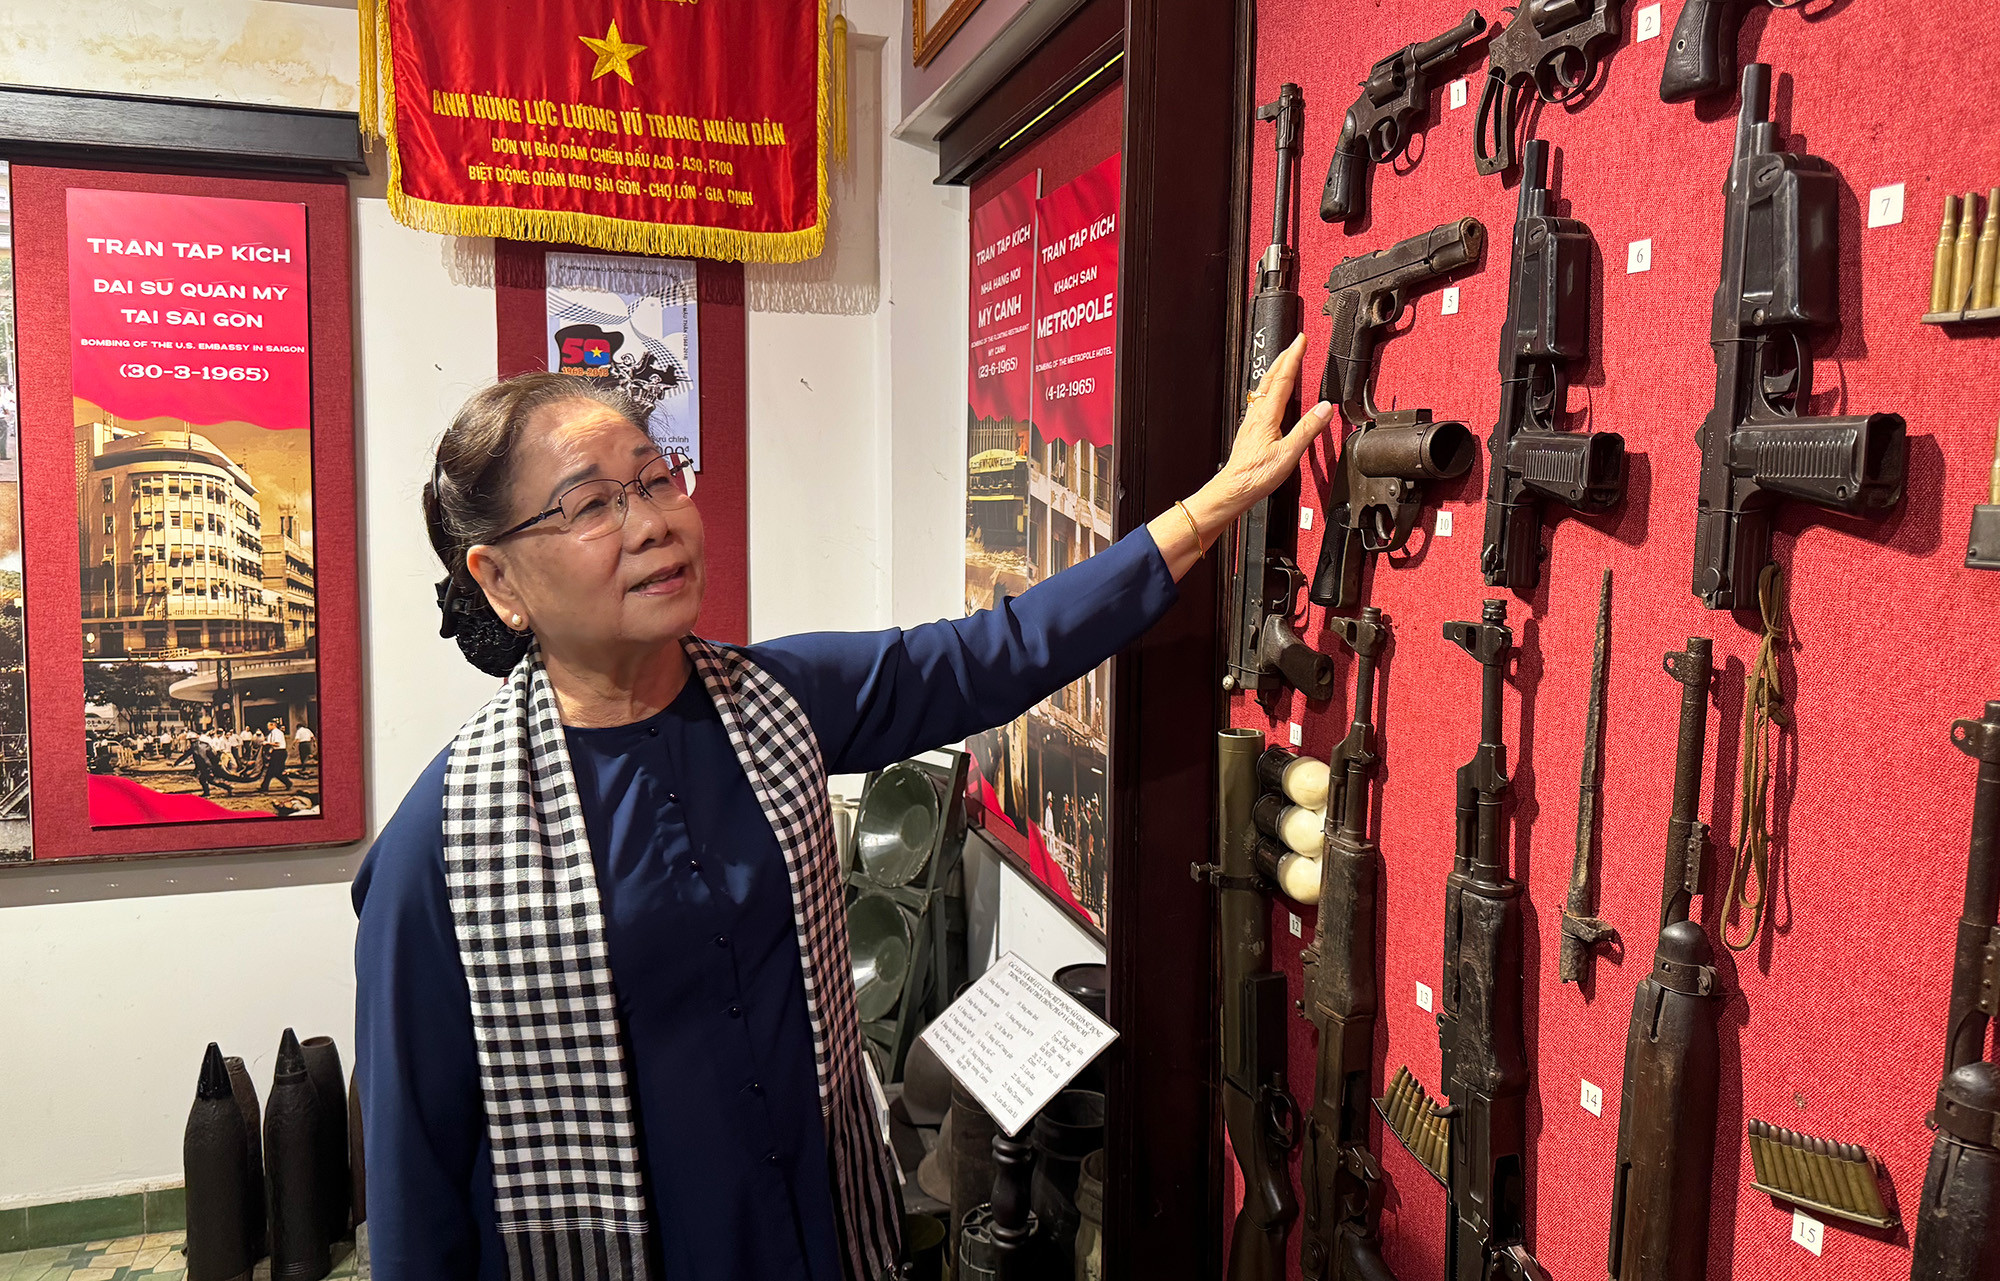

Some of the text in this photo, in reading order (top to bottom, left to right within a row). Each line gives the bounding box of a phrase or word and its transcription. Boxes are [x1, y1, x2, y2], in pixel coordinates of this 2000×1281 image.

[1645, 16, 1652, 31] 2
[433, 90, 786, 146] ANH HÙNG LỰC LƯỢNG VŨ TRANG NHÂN DÂN
[492, 138, 517, 154] ĐƠN
[520, 140, 533, 160] VỊ
[535, 135, 558, 158] BẢO
[561, 137, 588, 161] ĐẢM
[590, 143, 623, 165] CHIẾN
[626, 145, 650, 168] ĐẤU
[653, 154, 673, 170] A20
[709, 159, 734, 176] F100
[468, 162, 492, 184] BIỆT
[496, 164, 530, 186] ĐỘNG
[532, 168, 566, 188] QUÂN
[568, 172, 592, 190] KHU
[594, 172, 614, 192] SÀI
[616, 176, 640, 196] GÒN
[649, 182, 672, 202] CHỢ
[675, 181, 696, 200] LỚN
[705, 186, 724, 202] GIA
[728, 190, 754, 208] ĐỊNH
[1881, 197, 1890, 216] 7
[1637, 248, 1644, 263] 6
[1036, 292, 1114, 340] METROPOLE
[80, 338, 130, 348] BOMBING
[132, 340, 148, 348] OF
[150, 341, 173, 349] THE
[175, 342, 196, 350] U.S.
[198, 342, 250, 352] EMBASSY
[266, 345, 305, 353] SAIGON
[978, 356, 1018, 378] (23-6-1965)
[1035, 346, 1113, 372] BOMBING OF THE METROPOLE HOTEL
[120, 364, 270, 382] (30-3-1965)
[562, 366, 609, 378] 1968-2018
[1045, 378, 1096, 400] (4-12-1965)
[1440, 518, 1450, 530] 10
[1292, 919, 1300, 932] 12
[1420, 990, 1428, 1004] 13
[1586, 1090, 1597, 1107] 14
[1800, 1222, 1816, 1243] 15
